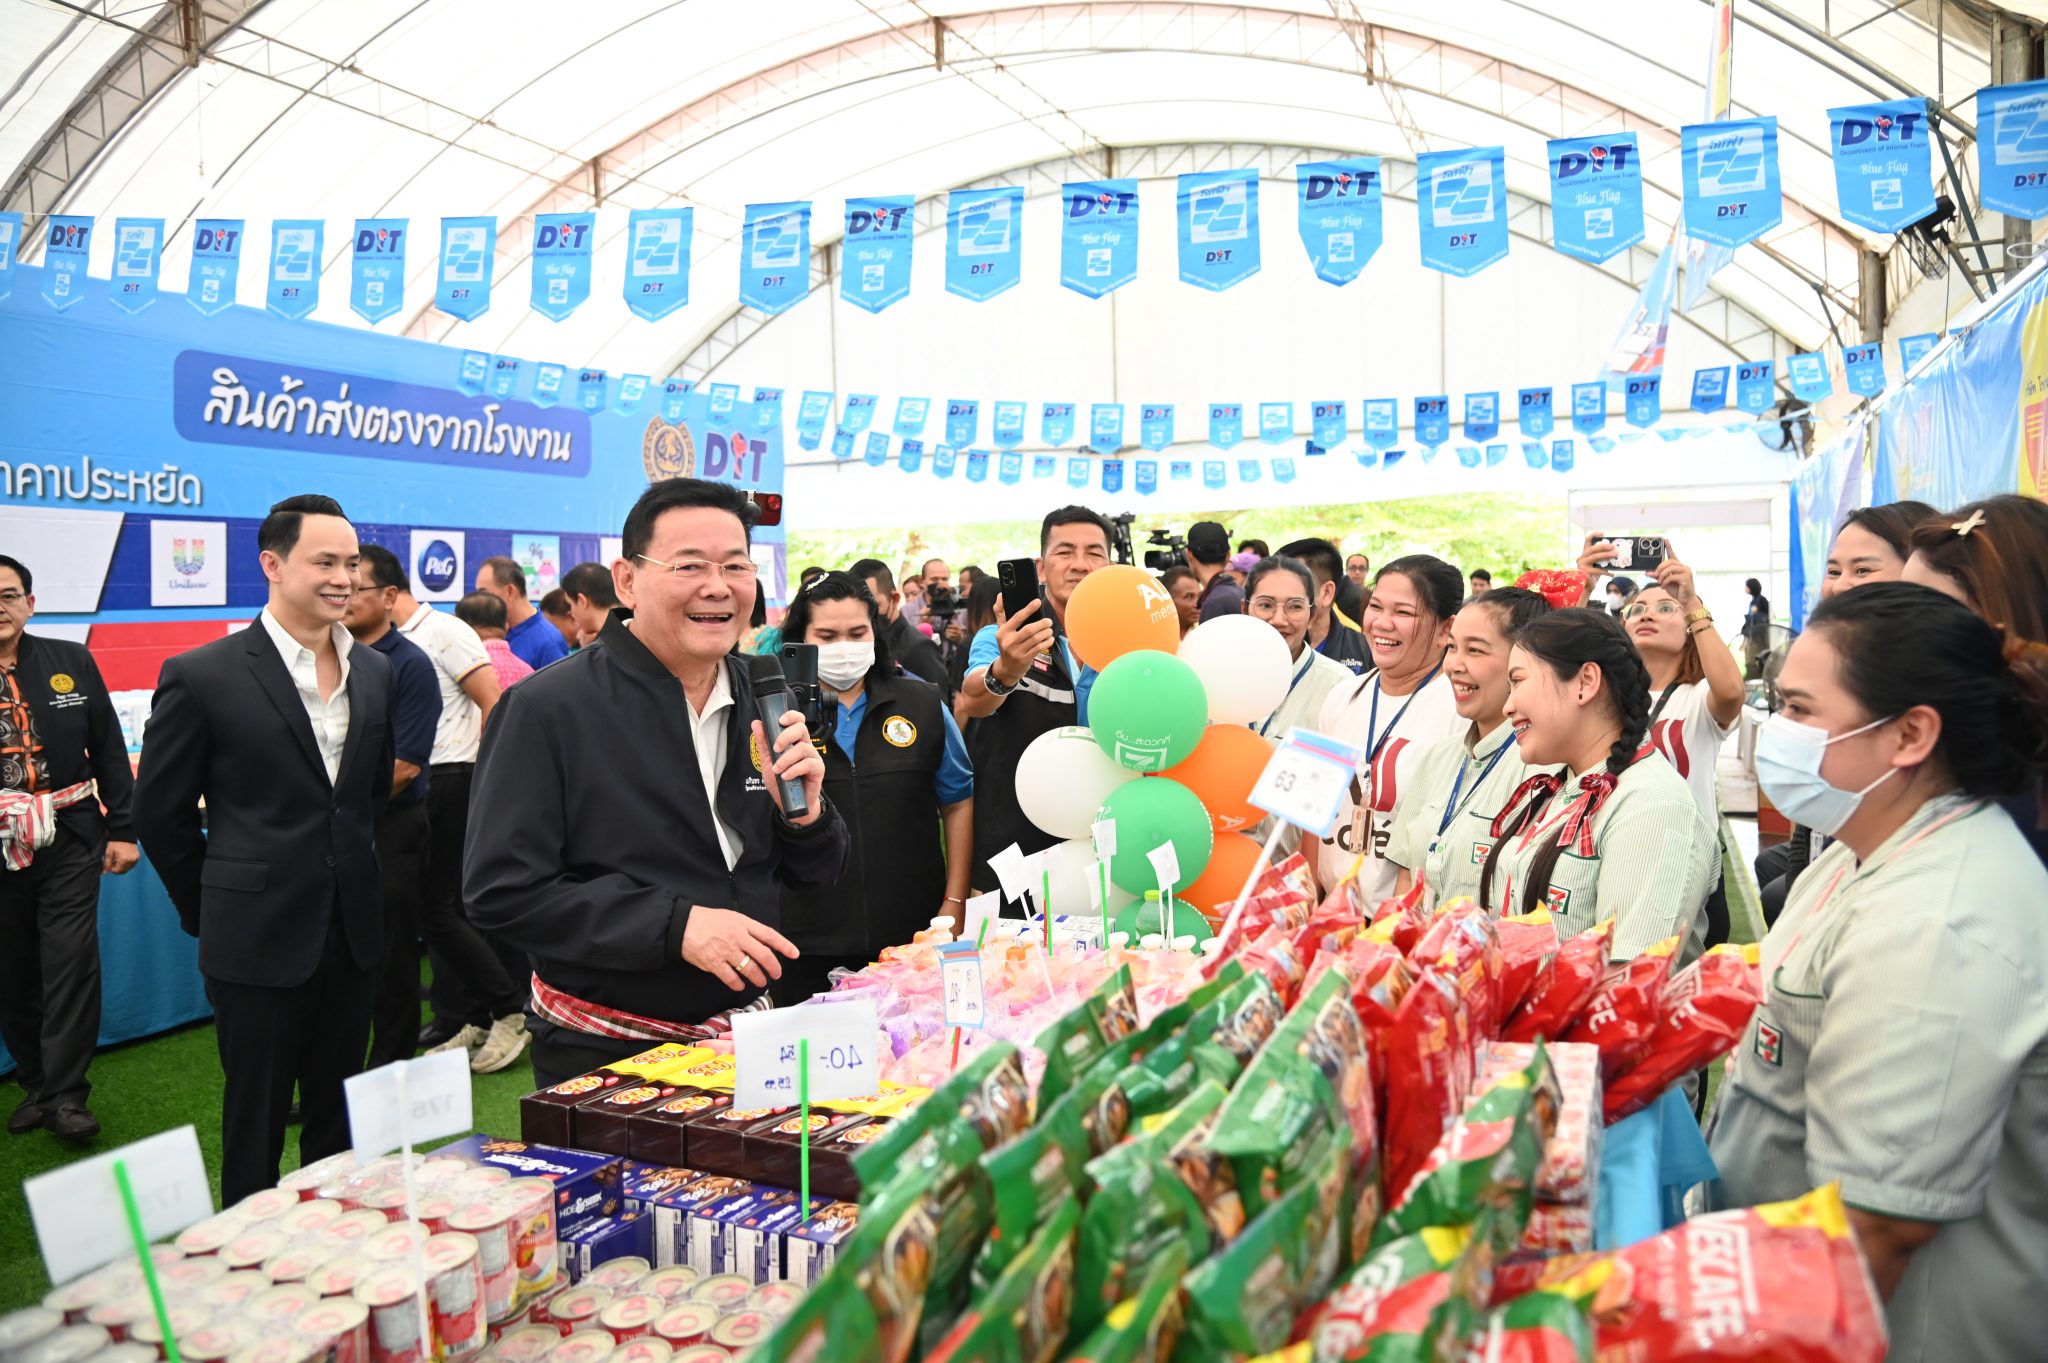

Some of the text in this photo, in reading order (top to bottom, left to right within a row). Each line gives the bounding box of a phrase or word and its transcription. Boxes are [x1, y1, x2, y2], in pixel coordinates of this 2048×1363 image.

[1842, 113, 1923, 145] DIT
[1559, 145, 1634, 178] DIT
[1860, 160, 1909, 175] Blue Flag
[1307, 172, 1376, 200] DIT
[2015, 173, 2047, 187] DIT
[1575, 189, 1621, 206] Blue Flag
[1066, 193, 1136, 217] DIT
[1717, 204, 1747, 217] DIT
[849, 208, 907, 234] DIT
[1320, 215, 1363, 230] Blue Flag
[50, 225, 88, 248] DIT
[196, 229, 238, 252] DIT
[356, 229, 401, 252] DIT
[537, 224, 588, 248] DIT
[1081, 231, 1120, 246] Blue Flag
[1450, 234, 1477, 246] DIT
[1206, 250, 1231, 262] DIT
[971, 264, 994, 274] DIT
[124, 284, 140, 292] DIT
[643, 283, 663, 292] DIT
[763, 277, 785, 286] DIT
[283, 288, 299, 296] DIT
[452, 290, 469, 298] DIT
[1847, 349, 1875, 364] DIT
[1740, 366, 1769, 380] DIT
[1629, 380, 1657, 394] DIT
[1522, 392, 1549, 405] DIT
[949, 405, 974, 416] DIT
[1045, 407, 1071, 417] DIT
[1212, 408, 1239, 418] DIT
[1315, 405, 1342, 417] DIT
[1418, 400, 1446, 413] DIT
[205, 367, 571, 463] สินค้าส่งตรงจากโรงงาน
[1144, 409, 1170, 419] DIT
[702, 432, 768, 483] DIT
[425, 557, 454, 577] P&G
